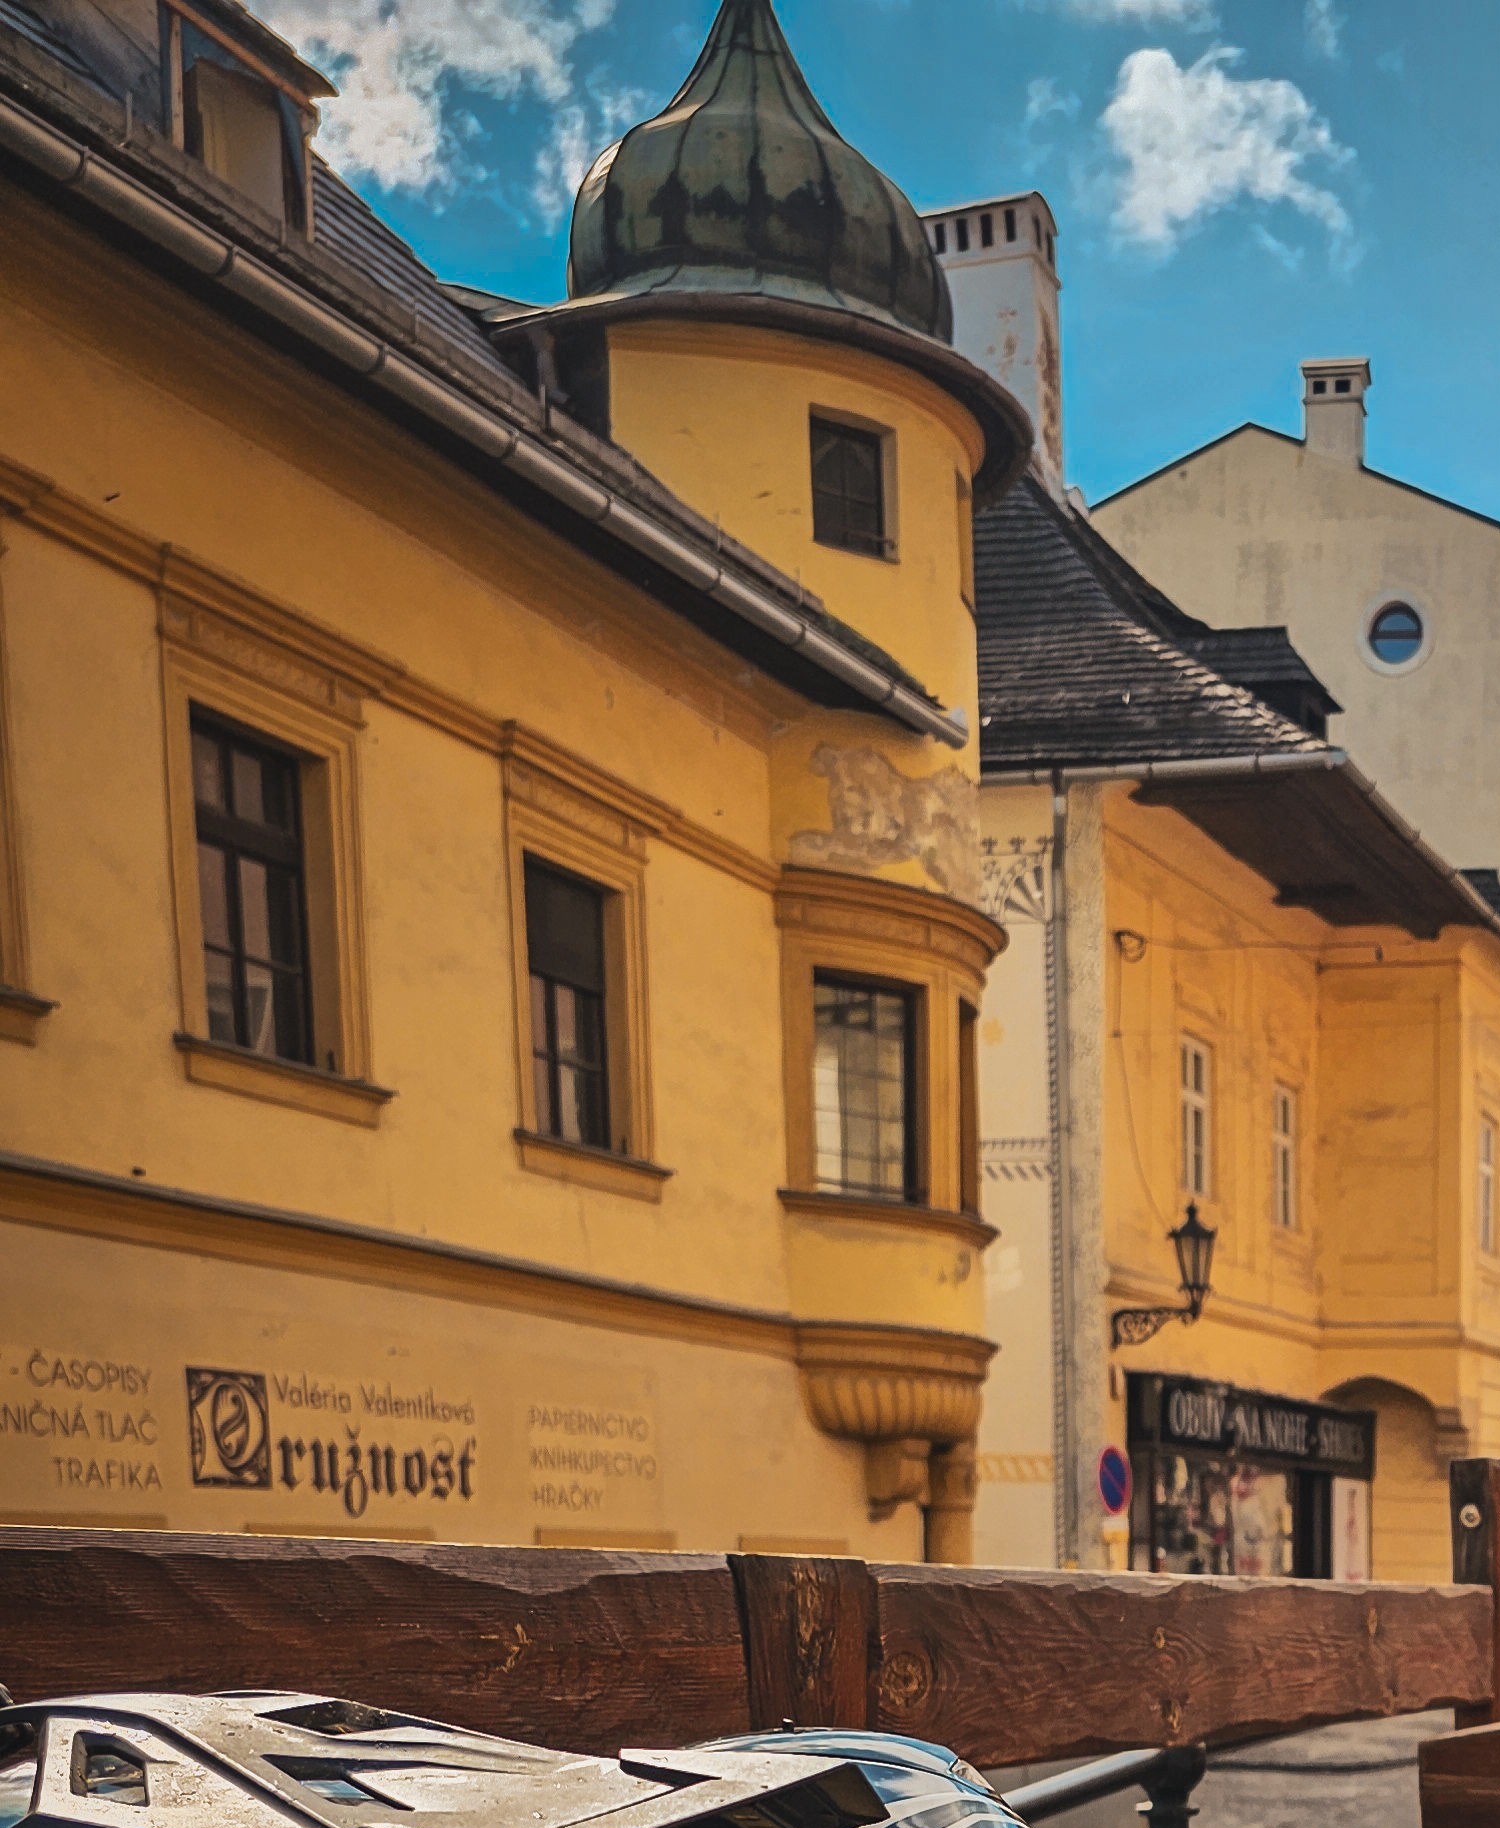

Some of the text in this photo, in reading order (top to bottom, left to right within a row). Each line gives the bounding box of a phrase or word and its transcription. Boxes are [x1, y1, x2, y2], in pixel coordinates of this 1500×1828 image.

[27, 1349, 152, 1396] ČASOPISY
[0, 1398, 158, 1445] NIČNÁ TLAČ
[52, 1456, 163, 1491] TRAFIKA
[532, 1481, 604, 1512] HRAČKY
